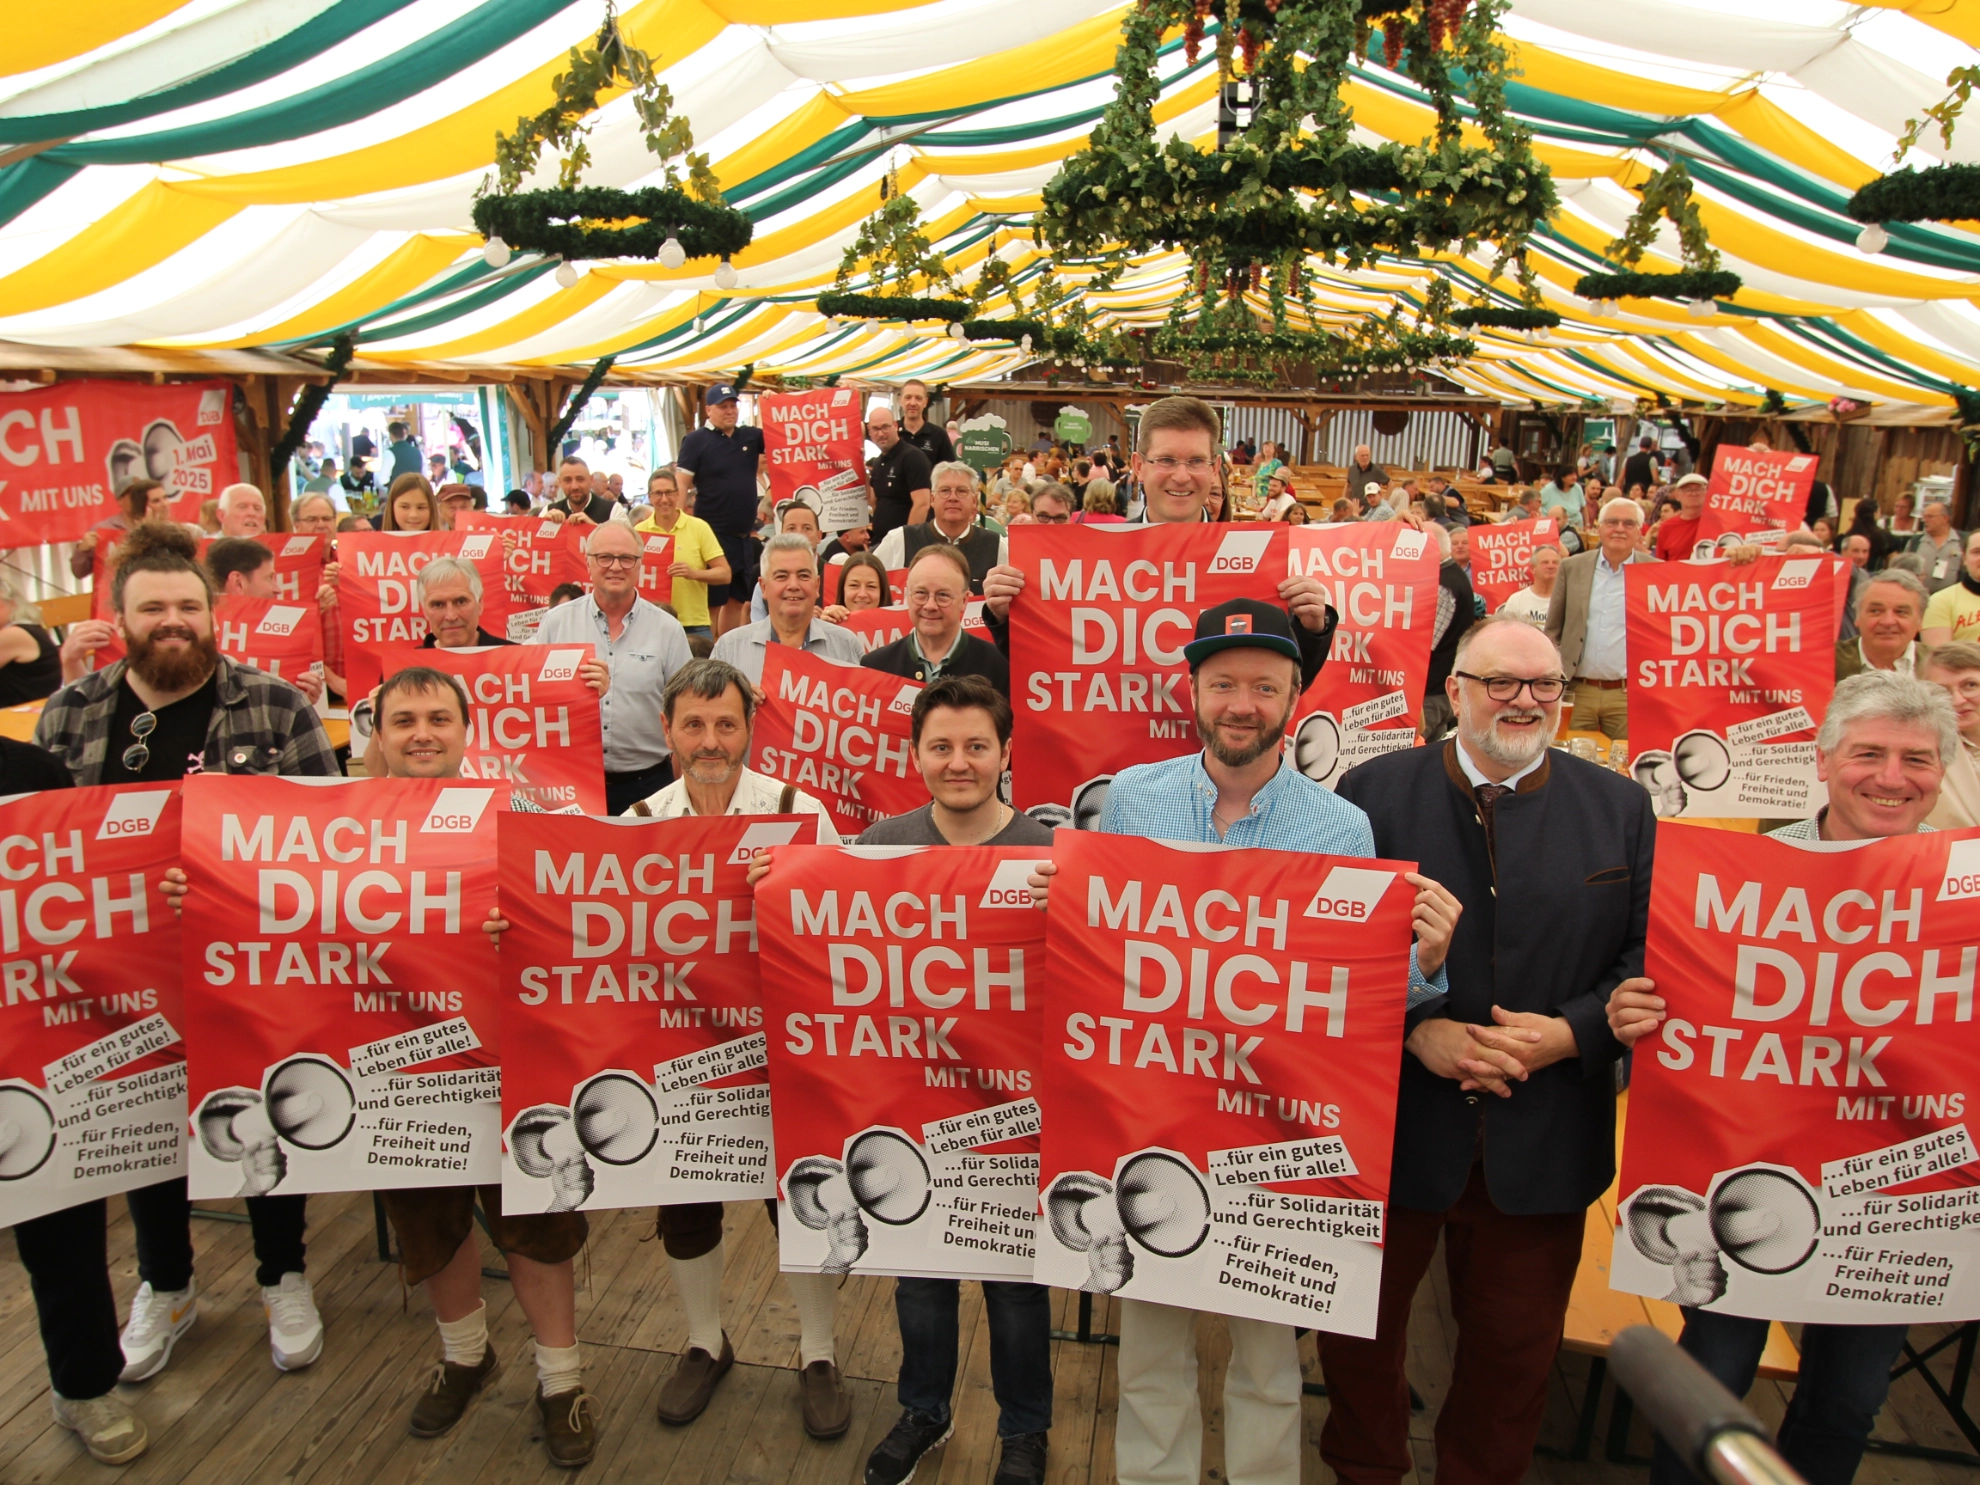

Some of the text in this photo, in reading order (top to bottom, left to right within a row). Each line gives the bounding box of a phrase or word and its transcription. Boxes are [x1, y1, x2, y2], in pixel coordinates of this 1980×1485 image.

[200, 411, 220, 423] DGB
[772, 404, 828, 422] MACH
[785, 419, 848, 445] DICH
[173, 444, 212, 466] 1. Mai
[772, 444, 828, 464] STARK
[173, 469, 208, 489] 2025
[1724, 457, 1781, 478] MACH
[21, 484, 103, 512] MIT UNS
[1730, 474, 1795, 502] DICH
[1710, 494, 1768, 514] STARK
[1396, 547, 1419, 558] DGB
[1478, 532, 1530, 548] MACH
[1217, 557, 1253, 570] DGB
[1478, 566, 1528, 585] STARK
[1040, 559, 1195, 602] MACH
[1320, 581, 1413, 630] ICH
[1648, 582, 1763, 612] MACH
[263, 622, 290, 633] DGB
[1071, 608, 1192, 666] DIC
[1671, 612, 1800, 655] DICH
[544, 668, 572, 678] DGB
[1350, 668, 1404, 686] MIT UNS
[1639, 658, 1754, 687] STARK
[780, 670, 880, 726] MACH
[1027, 672, 1183, 712] STARK
[1366, 701, 1379, 712] ein
[1381, 694, 1403, 710] gutes
[1730, 689, 1802, 703] MIT UNS
[1150, 720, 1190, 738] MIT
[1345, 704, 1403, 731] Leben für alle!
[1757, 717, 1772, 729] ein
[1775, 710, 1805, 725] gutes
[792, 709, 909, 778] DICH
[1371, 730, 1414, 742] Solidarität
[1732, 719, 1807, 746] Leben für alle!
[760, 746, 864, 799] STARK
[1764, 774, 1809, 789] Frieden,
[540, 786, 576, 800] UNS
[1738, 794, 1806, 809] Demokratie!
[1742, 783, 1808, 799] Freiheit und
[836, 799, 864, 818] MIT
[107, 818, 150, 834] DGB
[431, 815, 471, 829] DGB
[222, 814, 407, 863] MACH
[0, 830, 84, 880] CH
[536, 850, 714, 895] MACH
[259, 869, 461, 934] DICH
[989, 889, 1032, 904] DGB
[1317, 898, 1365, 918] DGB
[1695, 873, 1922, 944] MACH
[0, 873, 148, 953] ICH
[790, 889, 966, 939] MACH
[1088, 876, 1289, 950] MACH
[572, 900, 758, 958] DICH
[204, 942, 392, 985] STARK
[519, 962, 697, 1005] STARK
[828, 944, 1025, 1010] DICH
[1123, 940, 1349, 1038] DICH
[1732, 944, 1978, 1026] DICH
[43, 988, 158, 1027] MIT UNS
[354, 991, 462, 1012] MIT UNS
[660, 1007, 762, 1028] MIT UNS
[91, 1036, 117, 1058] ein
[120, 1019, 164, 1047] gutes
[396, 1033, 420, 1051] ein
[423, 1022, 466, 1044] gutes
[786, 1013, 961, 1059] STARK
[1064, 1013, 1264, 1084] STARK
[54, 1029, 170, 1094] Leben für alle!
[357, 1036, 471, 1078] Leben für alle!
[1657, 1019, 1892, 1086] STARK
[417, 1070, 501, 1087] Solidarität
[925, 1066, 1031, 1091] MIT UNS
[358, 1096, 389, 1110] und
[1218, 1088, 1340, 1128] MIT UNS
[1836, 1093, 1965, 1120] MIT UNS
[112, 1120, 179, 1140] Frieden,
[407, 1120, 471, 1139] Frieden,
[707, 1132, 769, 1153] Frieden,
[78, 1135, 178, 1161] Freiheit und
[373, 1135, 470, 1154] Freiheit und
[1259, 1147, 1285, 1163] ein
[1292, 1143, 1342, 1162] gutes
[1879, 1147, 1908, 1167] ein
[1914, 1131, 1965, 1159] gutes
[74, 1152, 177, 1178] Demokratie!
[368, 1152, 467, 1170] Demokratie!
[675, 1150, 767, 1168] Freiheit und
[670, 1167, 764, 1184] Demokratie!
[1215, 1159, 1346, 1186] Leben für alle!
[1828, 1146, 1968, 1199] Leben für alle!
[1280, 1197, 1380, 1218] Solidarität
[1213, 1210, 1379, 1238] und Gerechtigkeit
[1226, 1253, 1336, 1295] Freiheit und
[1265, 1244, 1338, 1278] Frieden,
[1219, 1271, 1331, 1313] Demokratie!
